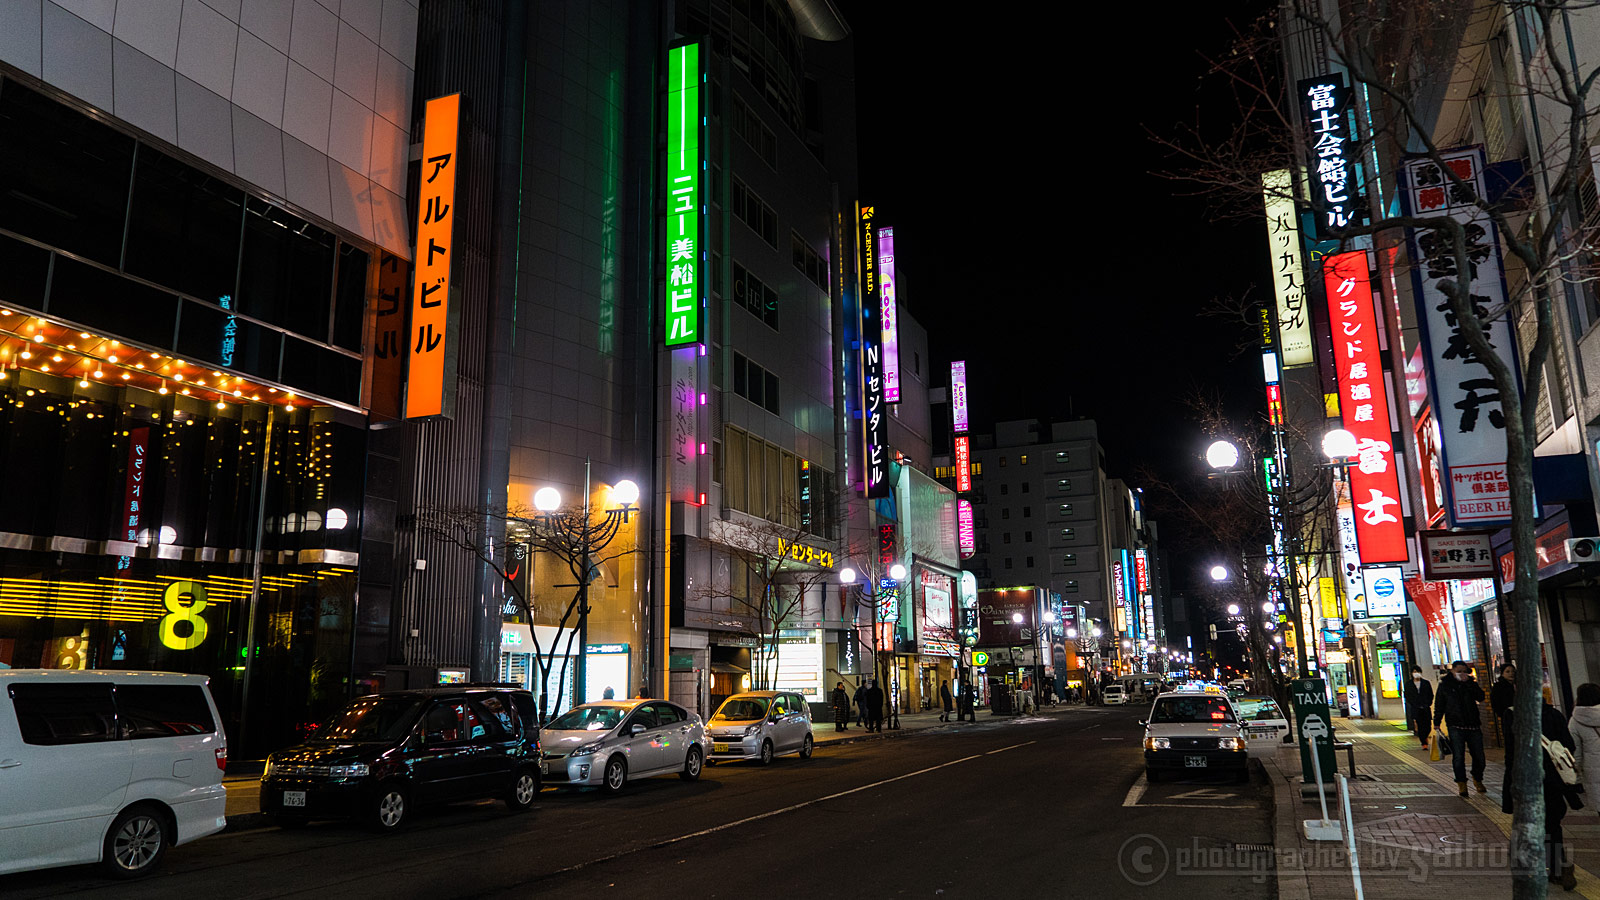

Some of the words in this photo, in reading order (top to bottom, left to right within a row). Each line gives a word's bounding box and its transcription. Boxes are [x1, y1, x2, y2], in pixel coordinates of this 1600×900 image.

[1308, 84, 1354, 227] 富士会館ビル
[414, 153, 452, 354] アルトビル
[670, 175, 693, 340] ニュー美松ビル
[1272, 212, 1304, 331] バッカスビル
[867, 345, 883, 486] N-センタービル
[1336, 277, 1374, 422] グランド居酒屋
[1357, 438, 1398, 526] 富士
[1454, 470, 1509, 483] サッポロビ
[1459, 502, 1494, 513] BEER
[777, 537, 834, 568] N-センタービル
[158, 580, 209, 650] 8
[1295, 693, 1326, 705] TAXI
